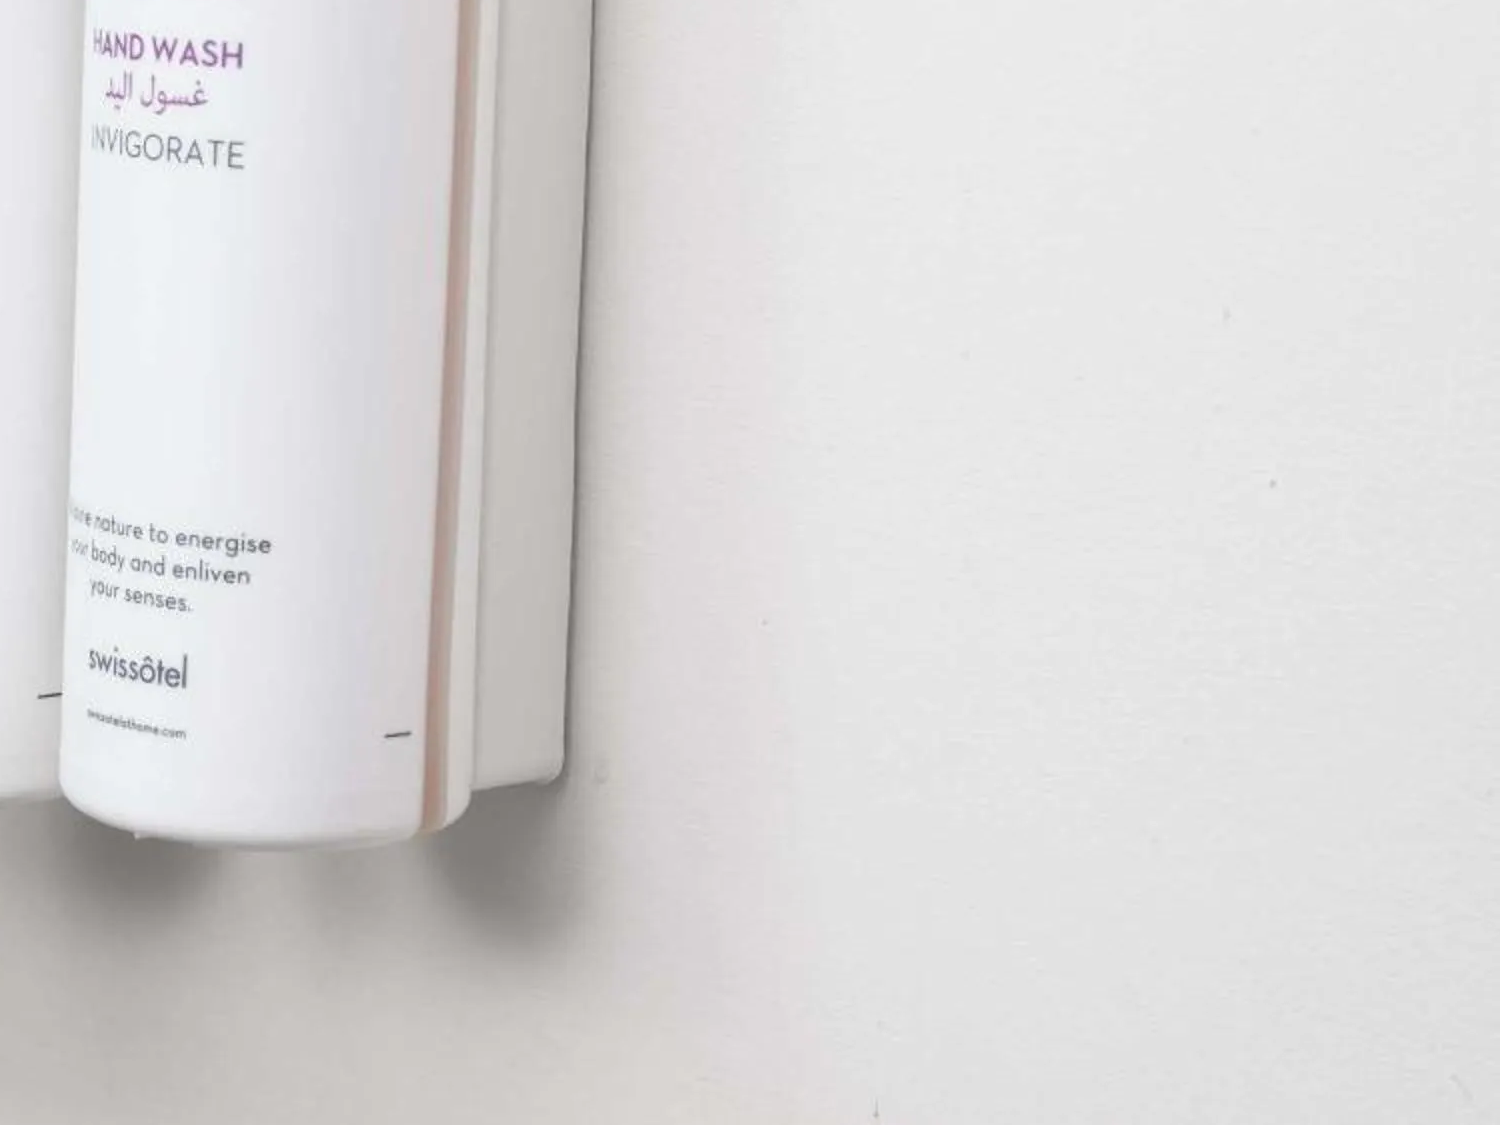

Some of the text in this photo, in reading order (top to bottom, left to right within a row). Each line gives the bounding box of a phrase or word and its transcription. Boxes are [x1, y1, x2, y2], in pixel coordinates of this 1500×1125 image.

[93, 27, 244, 69] HAND WASH
[91, 124, 245, 170] INVIGORATE
[95, 515, 143, 540] nature
[149, 523, 169, 544] to
[175, 532, 272, 557] energise
[91, 539, 125, 572] body
[130, 555, 165, 576] and
[172, 559, 251, 584] enliven
[89, 578, 192, 612] your senses.
[88, 646, 188, 689] swissôtel
